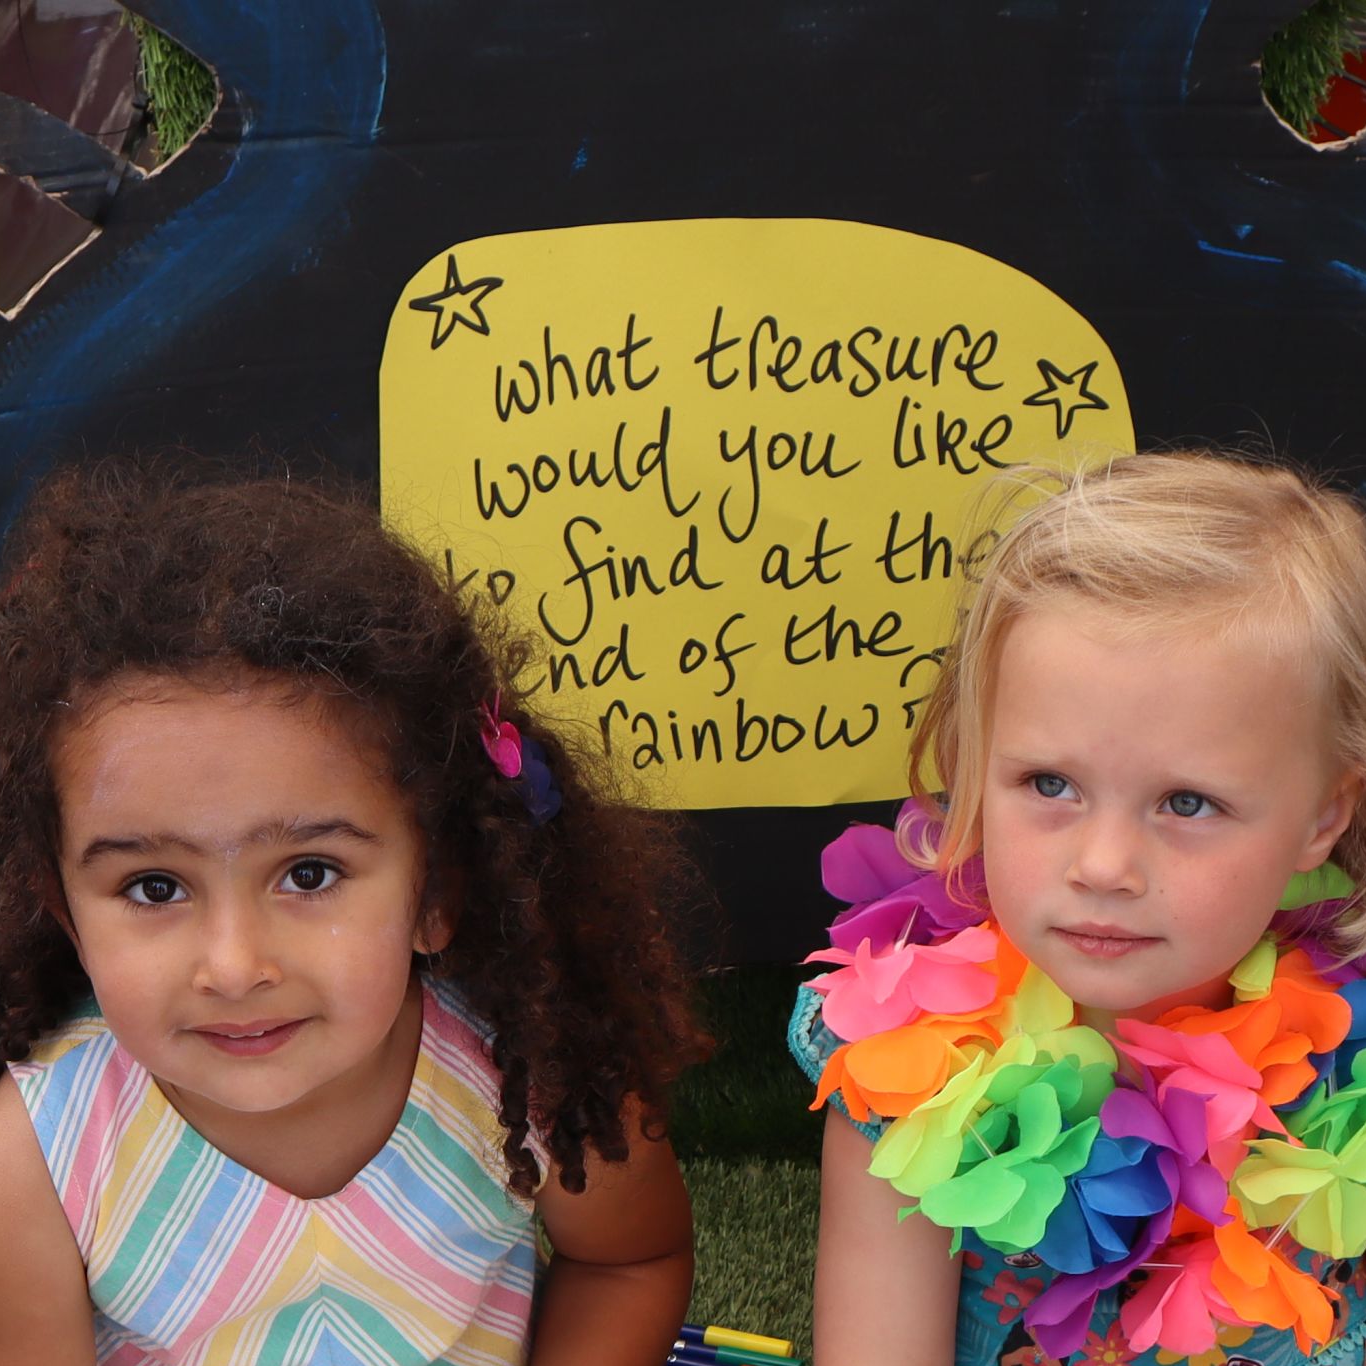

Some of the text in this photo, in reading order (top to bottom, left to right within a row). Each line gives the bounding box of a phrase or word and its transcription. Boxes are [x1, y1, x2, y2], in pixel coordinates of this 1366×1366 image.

[495, 306, 1005, 422] what treasure
[475, 395, 1018, 544] would you like
[537, 516, 724, 647] find
[761, 517, 852, 591] at
[679, 612, 757, 698] of
[784, 604, 915, 666] the
